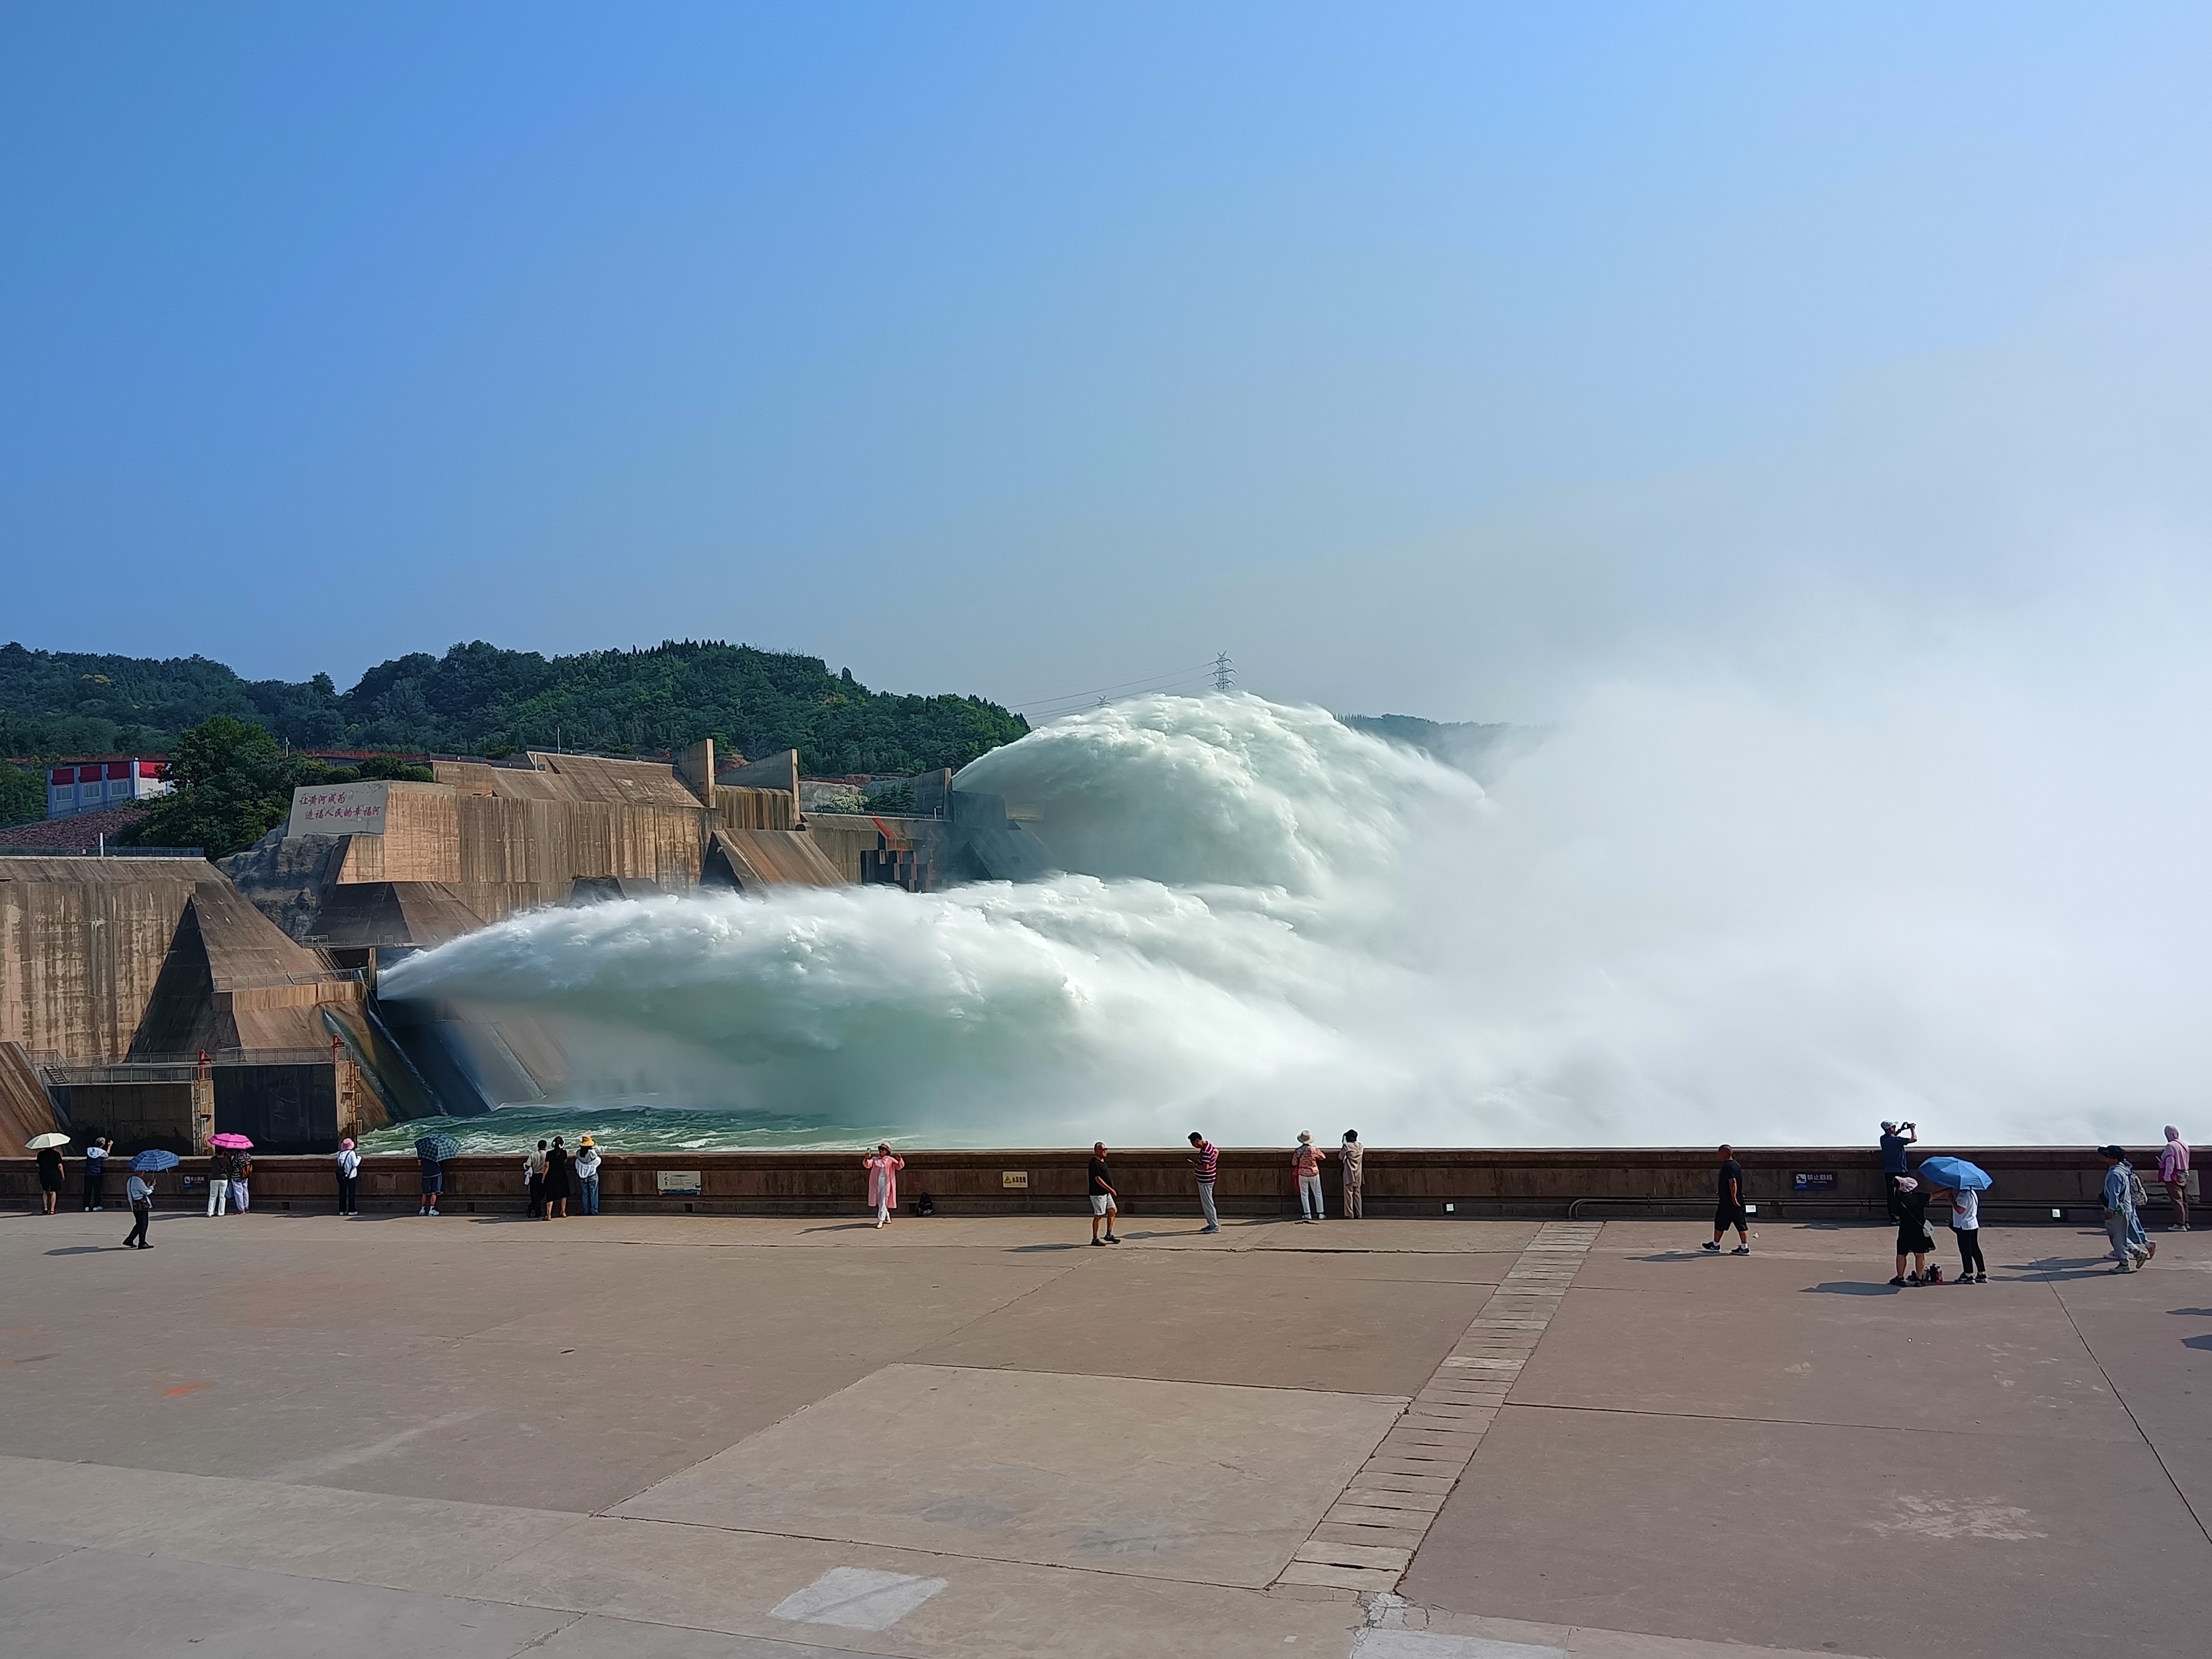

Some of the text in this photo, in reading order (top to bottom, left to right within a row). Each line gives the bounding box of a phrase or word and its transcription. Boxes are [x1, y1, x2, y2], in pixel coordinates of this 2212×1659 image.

[299, 792, 346, 806] 让黄河成为
[305, 805, 381, 820] 造福人民的幸福河
